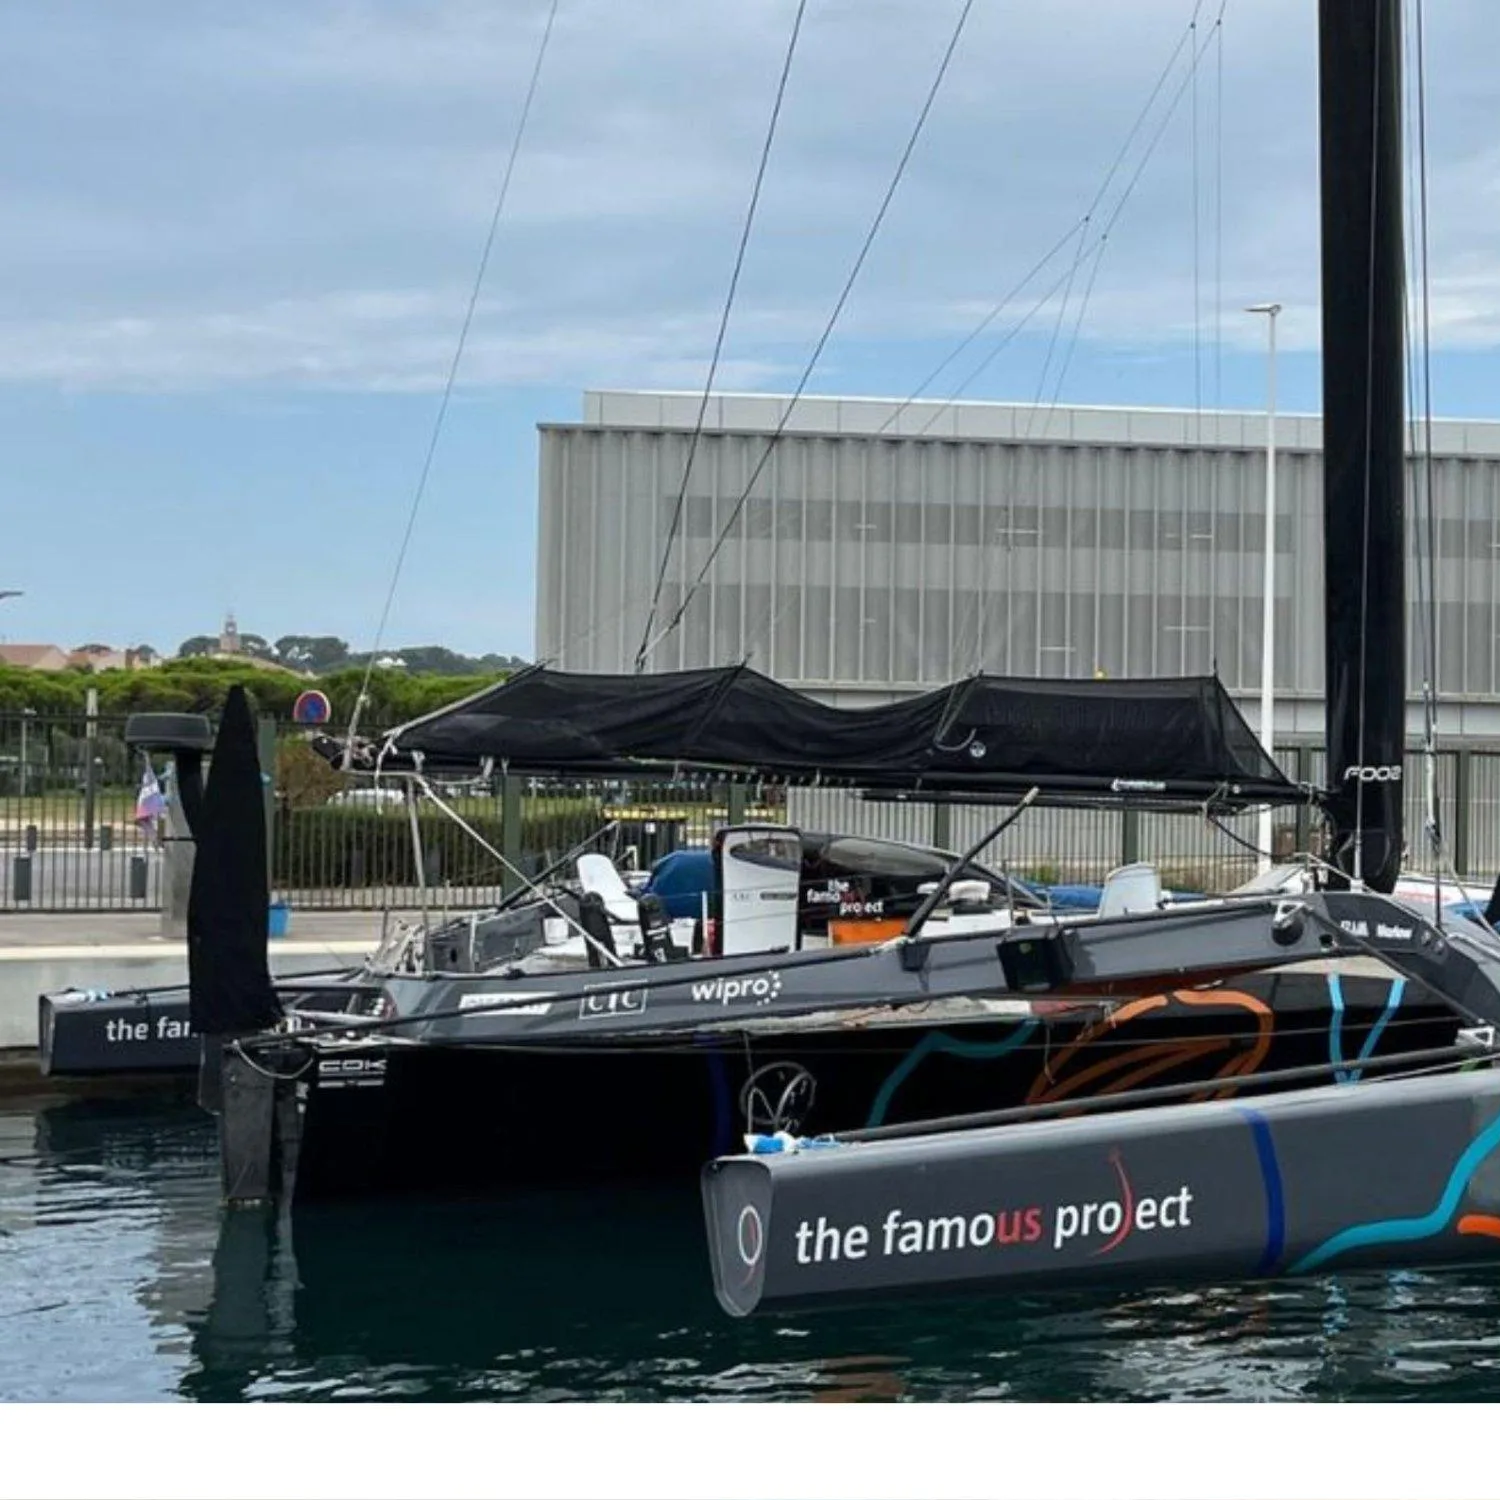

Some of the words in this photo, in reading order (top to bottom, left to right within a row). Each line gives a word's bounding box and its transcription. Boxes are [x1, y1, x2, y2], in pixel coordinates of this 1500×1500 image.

[691, 977, 769, 1006] wipro
[105, 1017, 149, 1042] the
[794, 1216, 869, 1265] the
[881, 1207, 1043, 1256] famous
[1053, 1150, 1193, 1256] project
